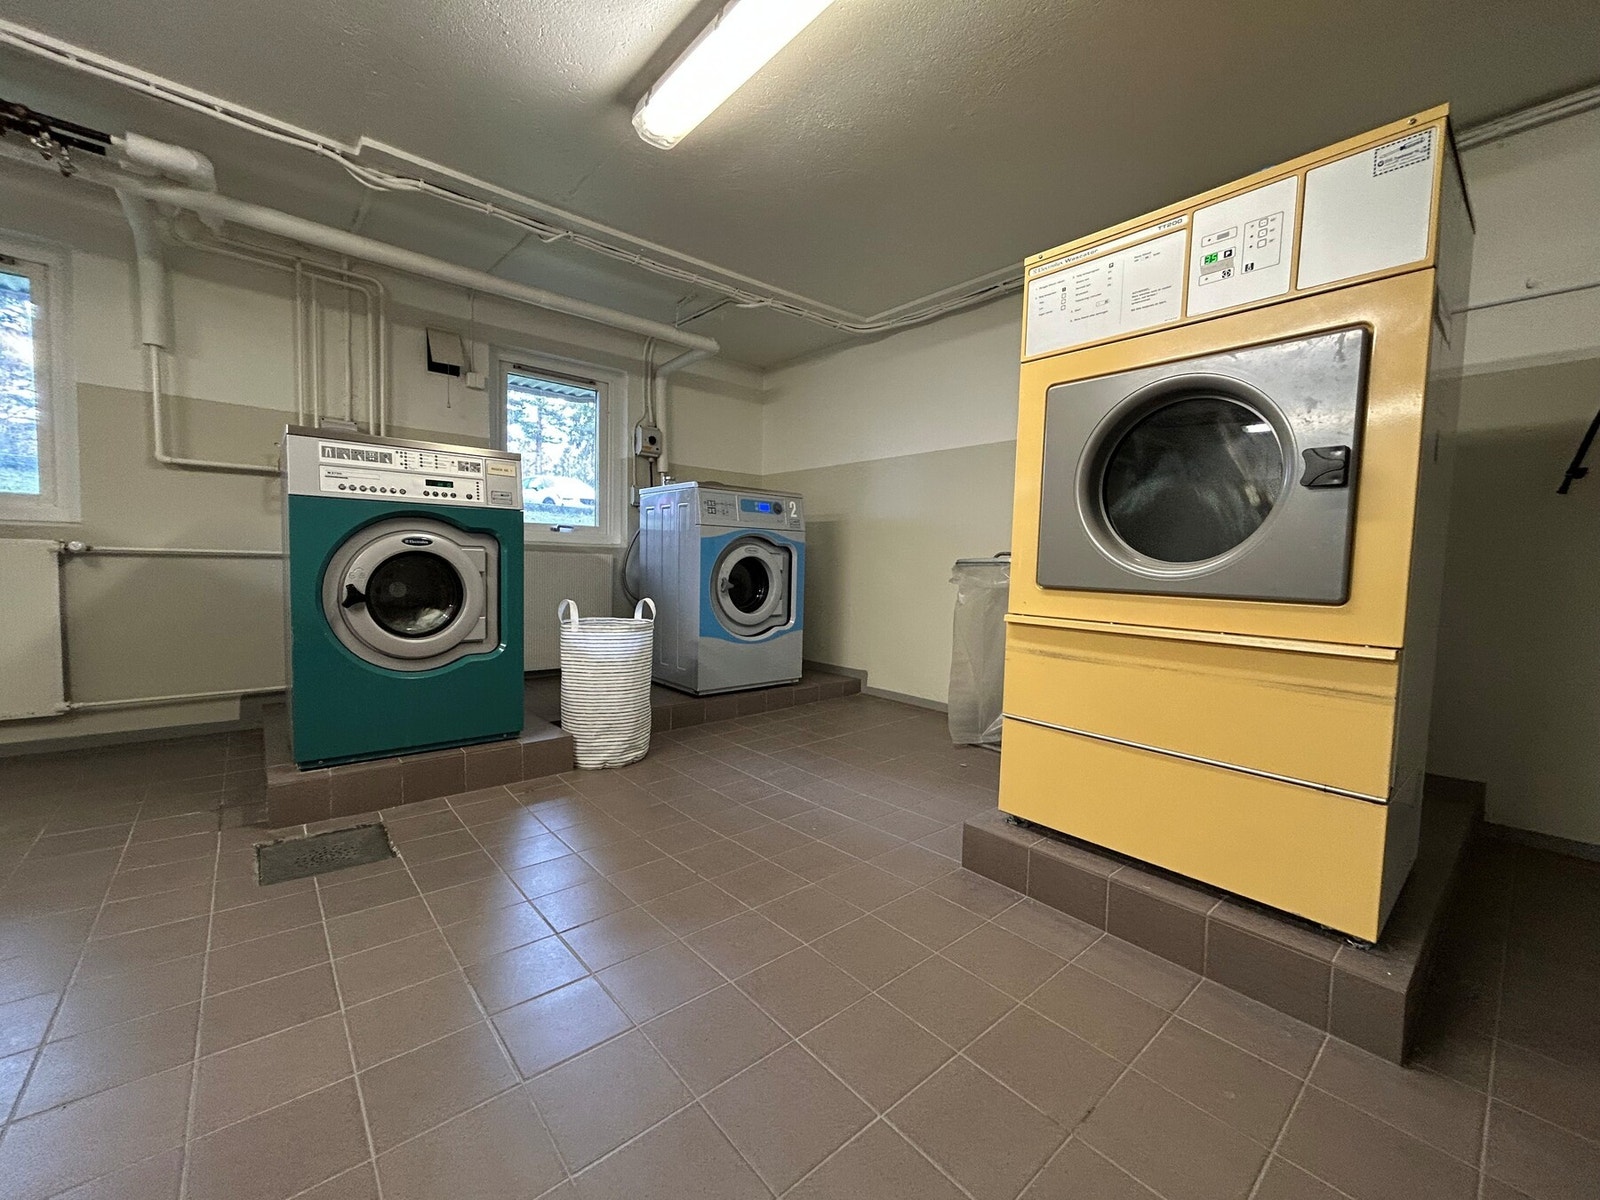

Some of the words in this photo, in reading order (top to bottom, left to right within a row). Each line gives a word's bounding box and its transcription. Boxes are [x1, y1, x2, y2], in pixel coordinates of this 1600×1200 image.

[1158, 218, 1183, 230] TT200
[1065, 249, 1098, 263] Wascator
[1204, 252, 1218, 265] 35
[789, 501, 797, 517] 2
